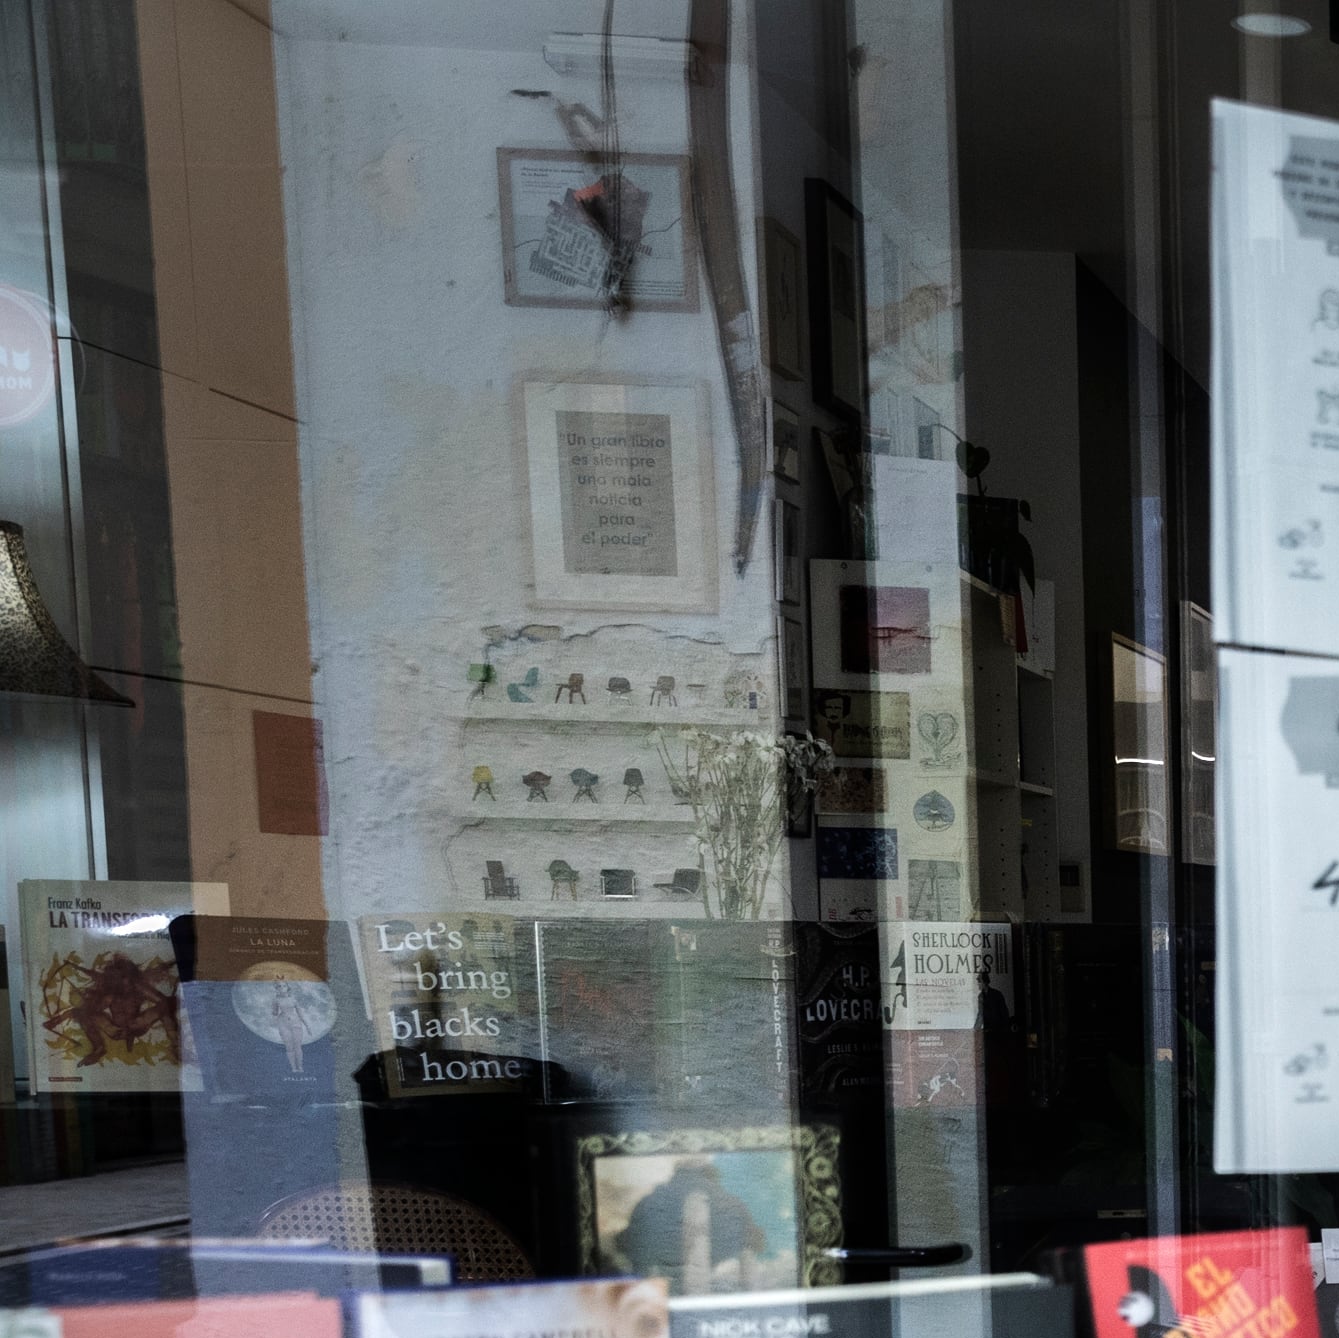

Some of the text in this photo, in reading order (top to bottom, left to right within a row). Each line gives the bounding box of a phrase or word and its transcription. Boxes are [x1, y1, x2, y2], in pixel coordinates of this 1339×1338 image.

[591, 435, 666, 449] gran libro
[571, 454, 656, 468] es siempre
[577, 474, 652, 487] una mala
[589, 494, 642, 507] noticia
[600, 513, 635, 527] para
[582, 531, 596, 544] el
[48, 897, 102, 910] Franz Kafka
[50, 912, 68, 929] LA
[250, 938, 296, 947] LA LUNA
[912, 932, 992, 949] SHERLOCK
[913, 953, 994, 975] HOLMES
[414, 962, 512, 999] bring
[842, 965, 871, 988] H.P.
[771, 959, 784, 1073] LOVECRAFT
[806, 999, 884, 1023] LOVECRA
[388, 1008, 501, 1040] blacks
[420, 1052, 523, 1082] home
[1186, 1256, 1233, 1298] EL
[700, 1312, 831, 1338] NICK CAVE
